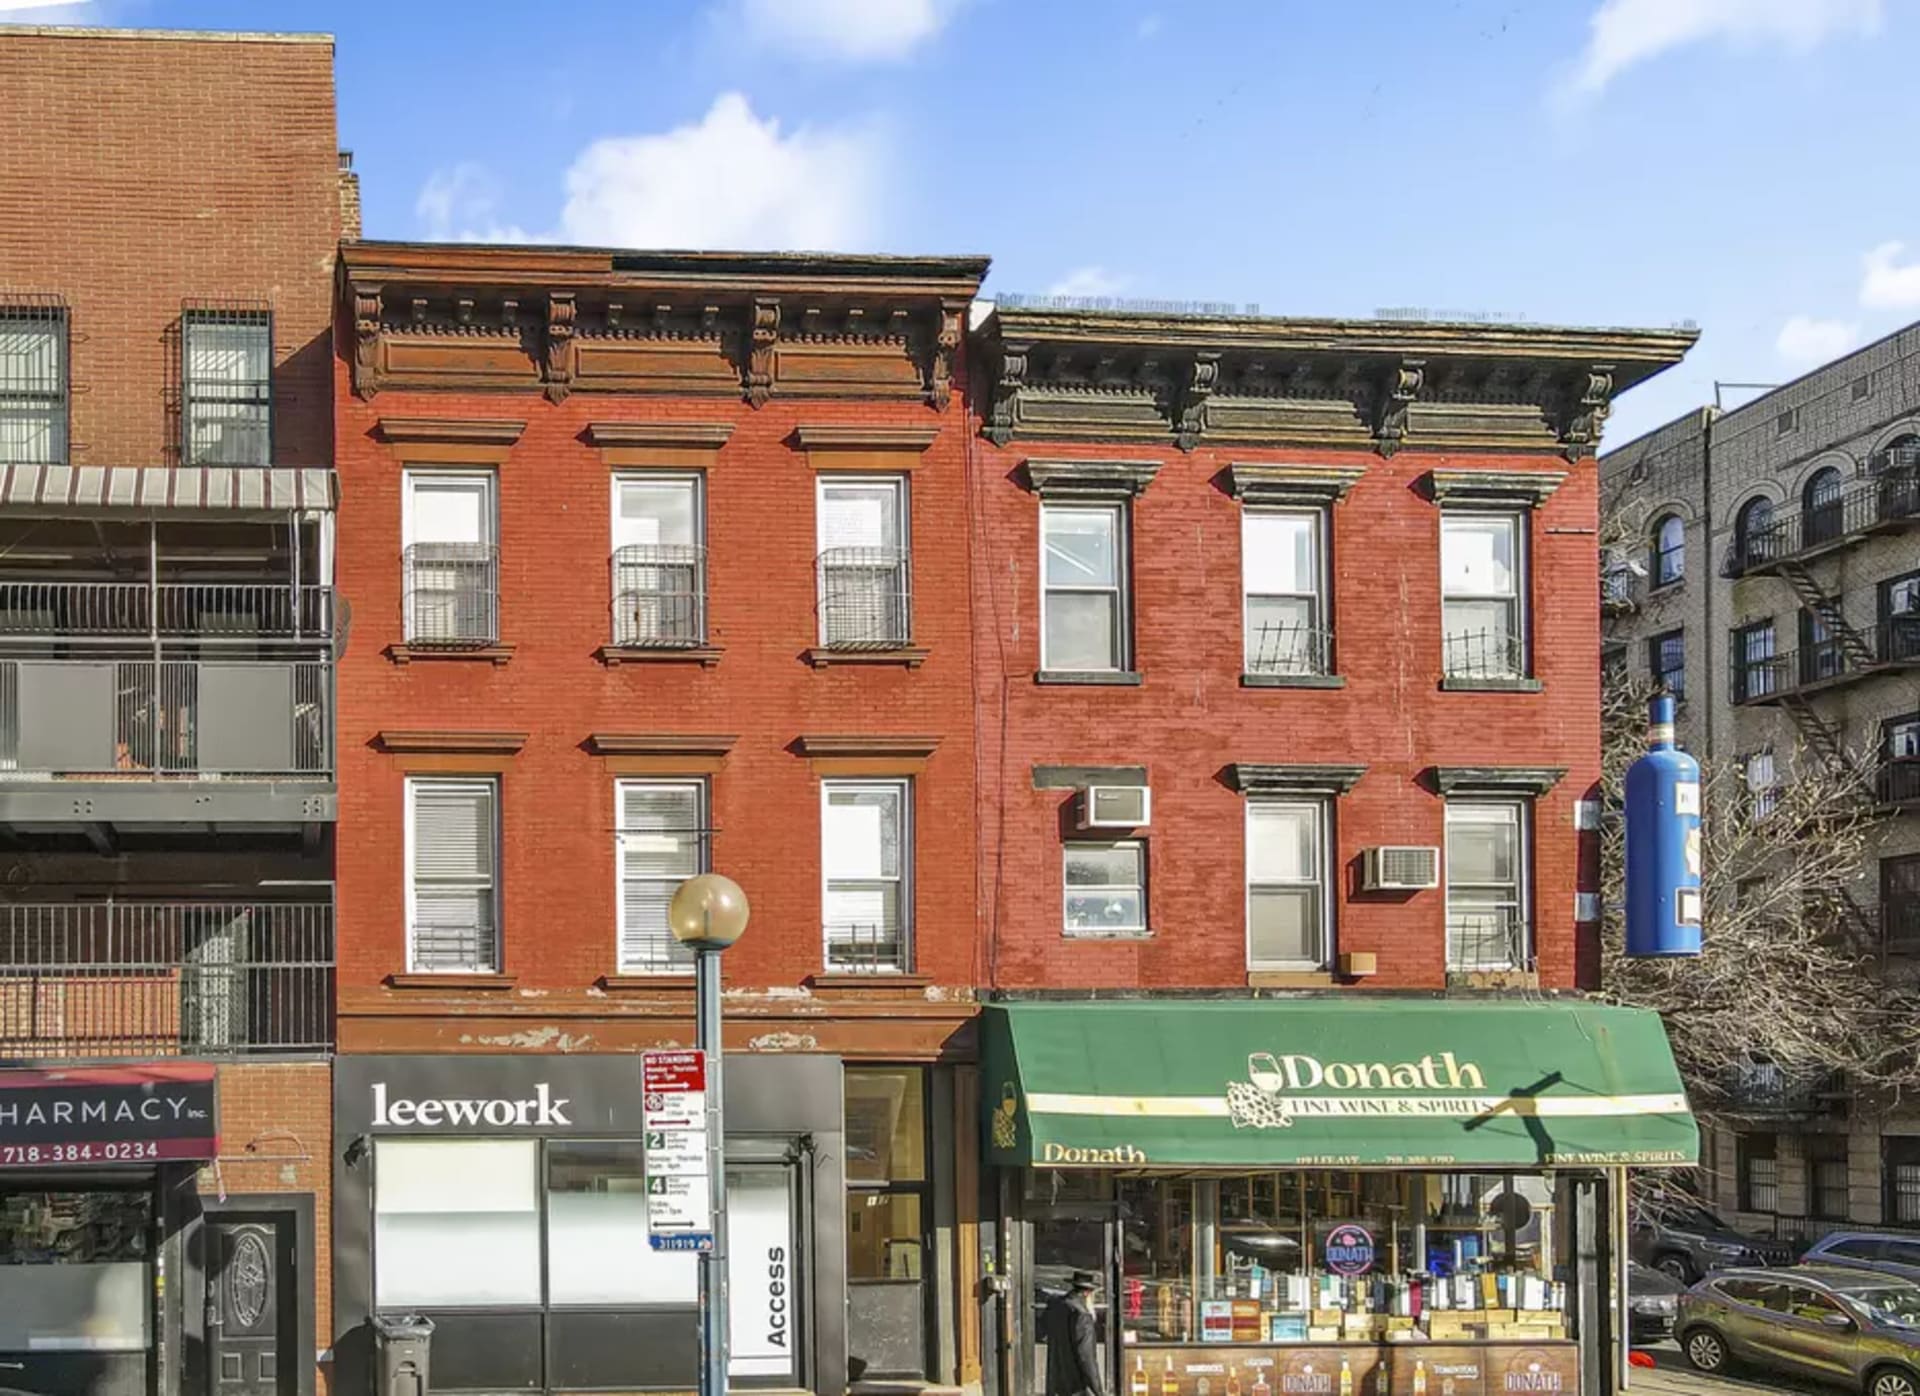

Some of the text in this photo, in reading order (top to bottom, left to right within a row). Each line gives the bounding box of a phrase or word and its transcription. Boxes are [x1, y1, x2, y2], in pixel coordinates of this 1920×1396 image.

[1279, 1052, 1487, 1089] Donath
[371, 1083, 572, 1126] leework
[1341, 1100, 1389, 1113] WINE
[1399, 1100, 1409, 1113] &
[1418, 1099, 1494, 1113] SPIRITS
[650, 1133, 661, 1148] 2
[5, 1142, 158, 1163] 718-384-0234
[1044, 1143, 1146, 1164] Donath
[1578, 1152, 1617, 1163] WINE
[1619, 1151, 1631, 1163] &
[1633, 1151, 1686, 1161] SPIRITS
[651, 1177, 662, 1193] 4
[1326, 1246, 1374, 1263] DONATH
[767, 1246, 786, 1348] Access
[1283, 1374, 1331, 1393] DONATH
[1504, 1372, 1562, 1392] DONATH
